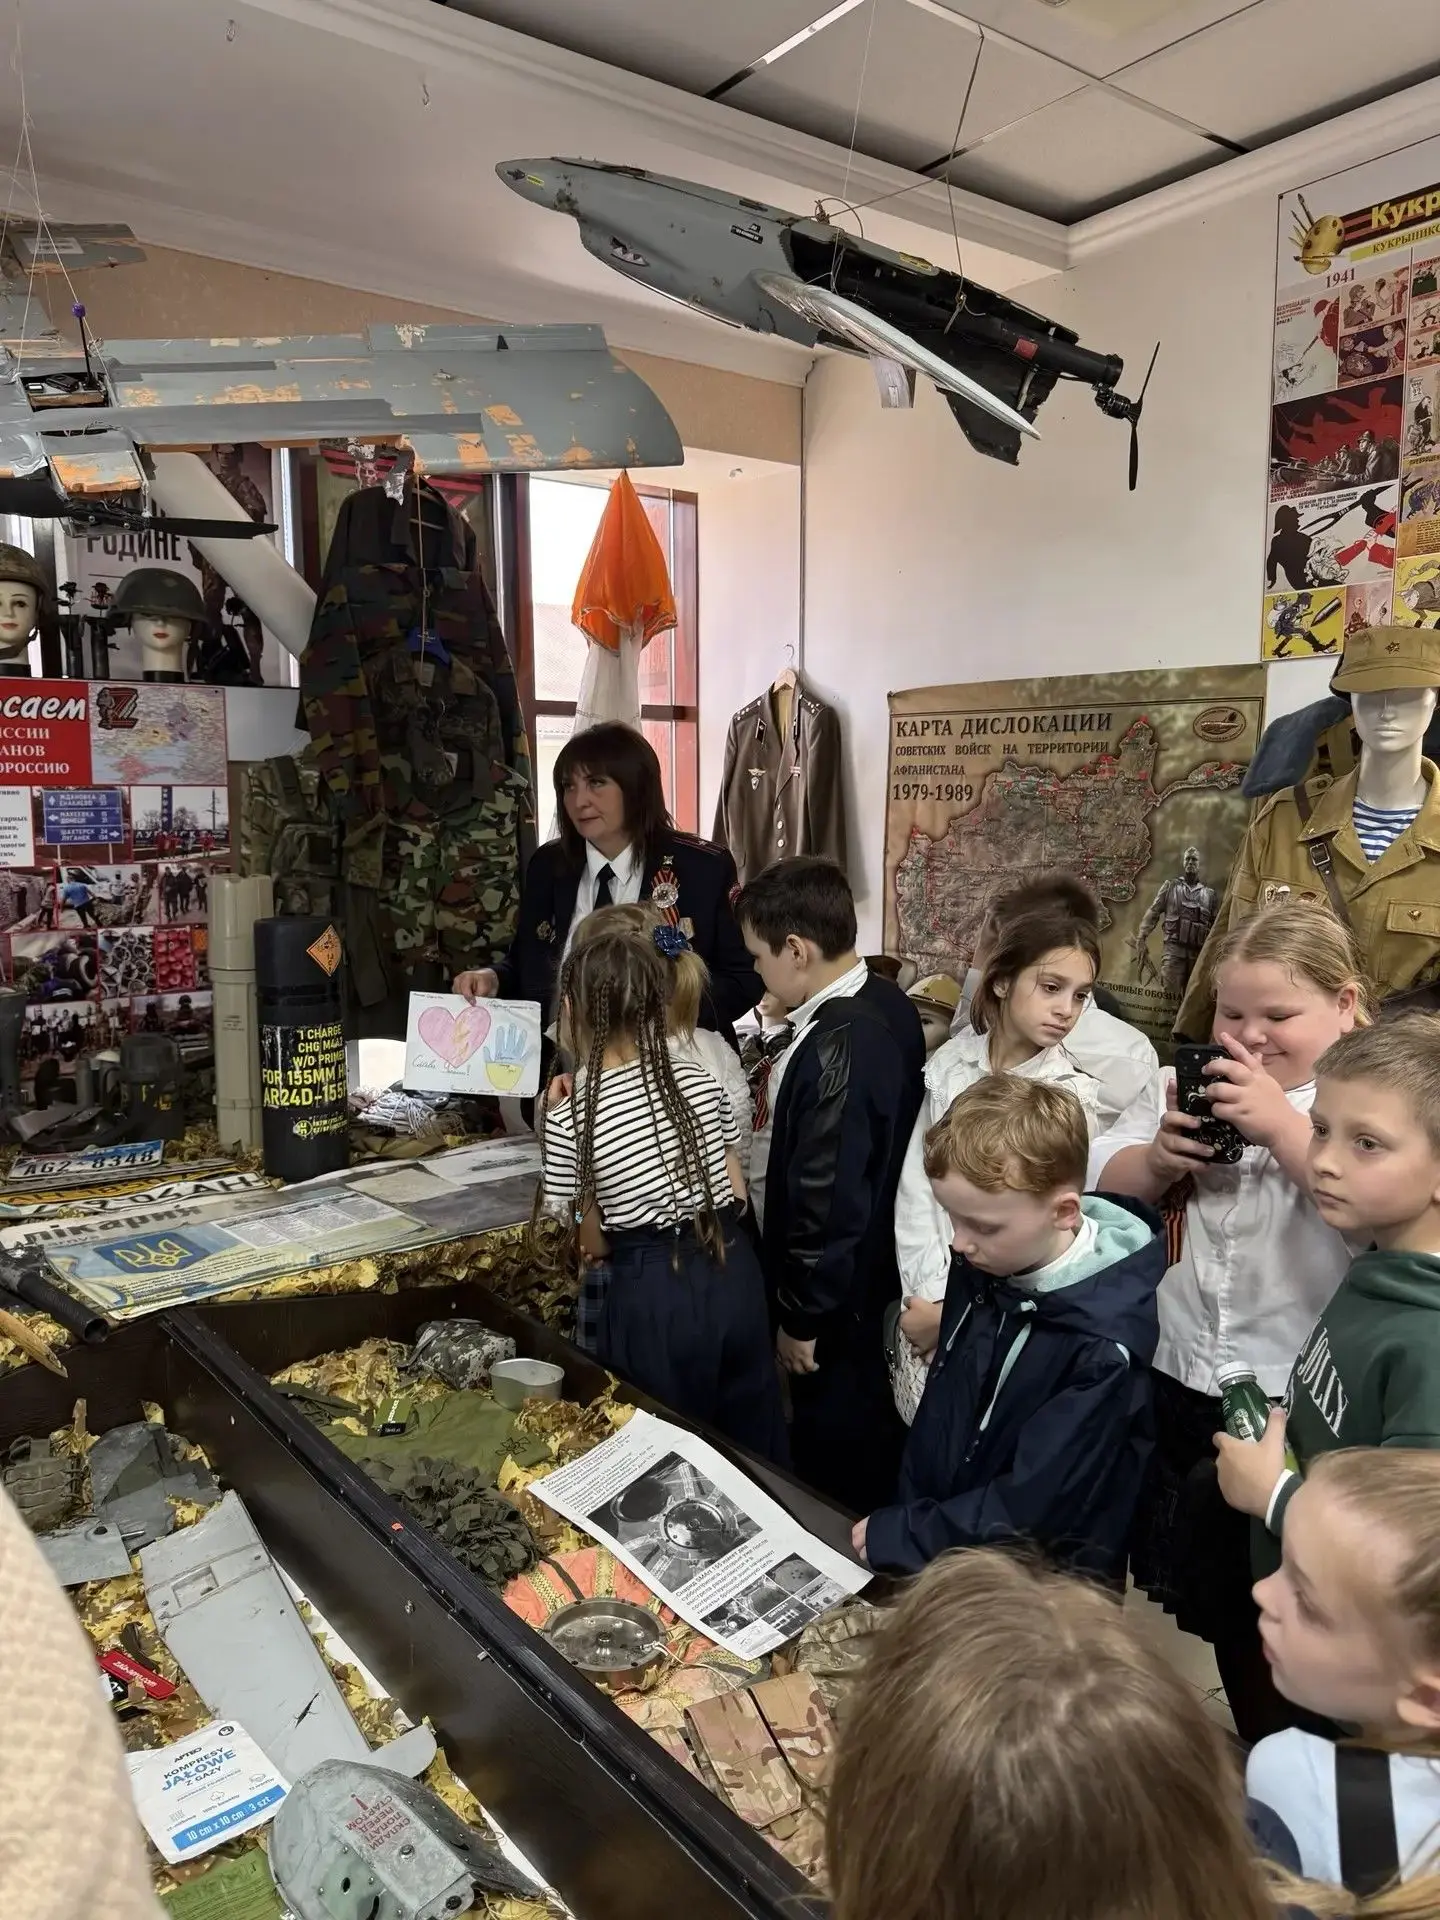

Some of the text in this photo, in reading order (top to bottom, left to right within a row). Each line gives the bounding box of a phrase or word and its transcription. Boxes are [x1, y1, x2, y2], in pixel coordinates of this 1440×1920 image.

[1372, 191, 1440, 229] Кукр
[1327, 268, 1354, 288] 1941
[88, 527, 181, 562] РОДИНЕ
[0, 695, 86, 720] саем
[0, 727, 50, 739] ССИИ
[896, 713, 1113, 739] КАРТА ДИСЛОКАЦИИ
[0, 744, 46, 756] АНОВ
[896, 741, 1109, 756] СОВЕТСКИХ ВОЙСК НА ТЕРРИТОРИИ
[894, 764, 966, 776] АФГАНИСТАНА
[893, 784, 973, 801] 1979-1989
[307, 1024, 342, 1039] CHARGE
[298, 1042, 320, 1053] CHG
[292, 1055, 315, 1068] W/O
[262, 1067, 282, 1085] FOR
[287, 1066, 336, 1086] 155MM
[92, 1150, 153, 1168] 8348
[711, 1561, 722, 1571] 155
[162, 1749, 236, 1791] JAŁOWE
[164, 1747, 224, 1779] KOMPRESY
[196, 1765, 222, 1782] GAZY
[186, 1829, 198, 1841] 10
[198, 1824, 212, 1836] cm
[212, 1822, 220, 1830] x
[219, 1815, 230, 1826] 10
[230, 1809, 245, 1821] cm
[248, 1802, 256, 1811] 3
[344, 1794, 394, 1831] СТАРТОМ
[358, 1805, 394, 1834] ПЕРЕД
